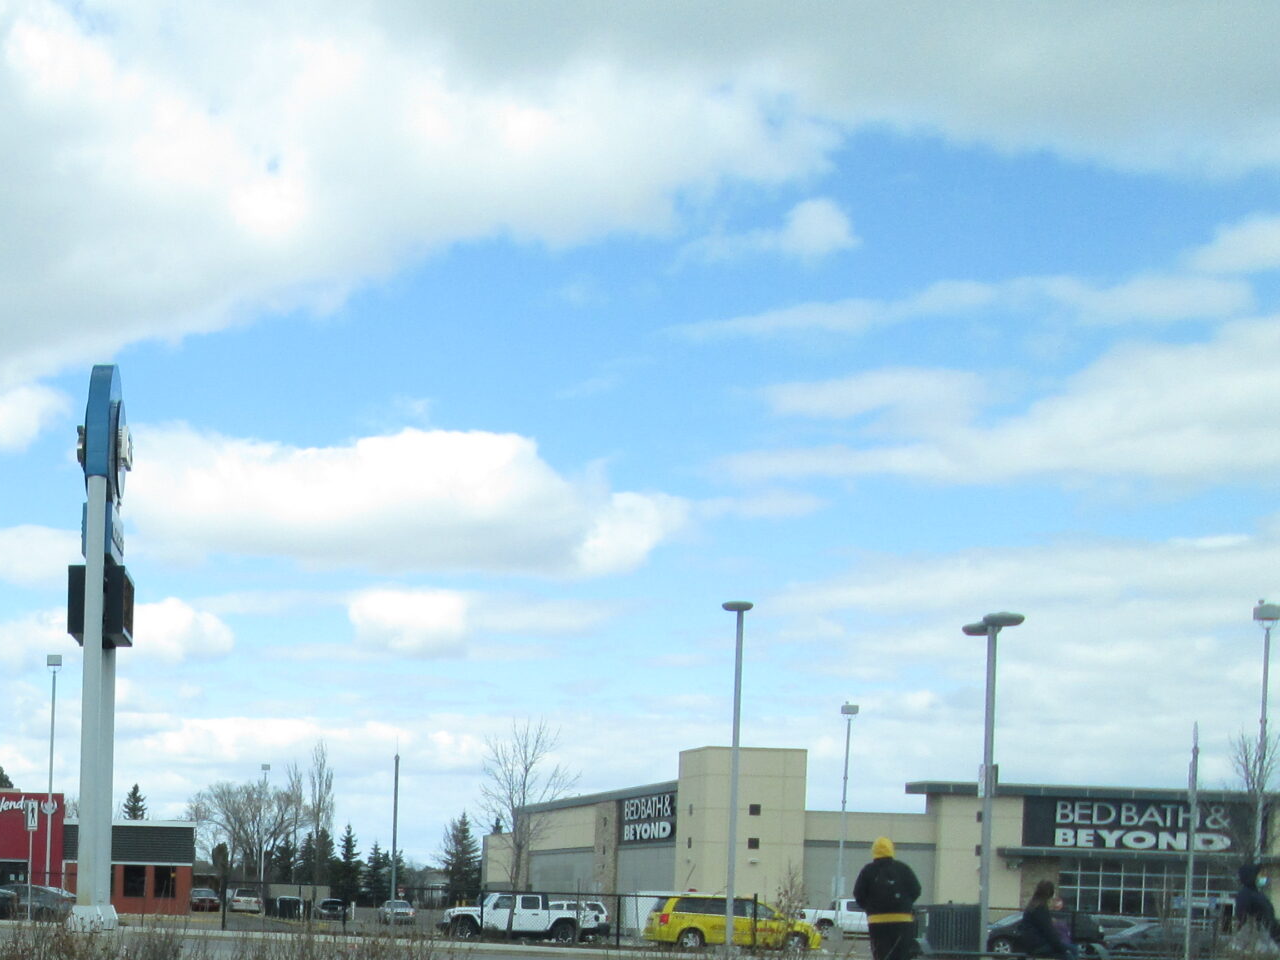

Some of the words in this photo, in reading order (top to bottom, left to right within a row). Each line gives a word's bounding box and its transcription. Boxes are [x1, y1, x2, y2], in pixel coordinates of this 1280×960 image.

[624, 799, 640, 820] BED
[641, 795, 664, 819] BATH
[663, 794, 672, 817] &
[1055, 801, 1117, 825] BED
[1120, 803, 1201, 829] BATH
[1205, 805, 1232, 830] &
[624, 821, 671, 841] BEYOND
[1054, 828, 1232, 851] BEYOND
